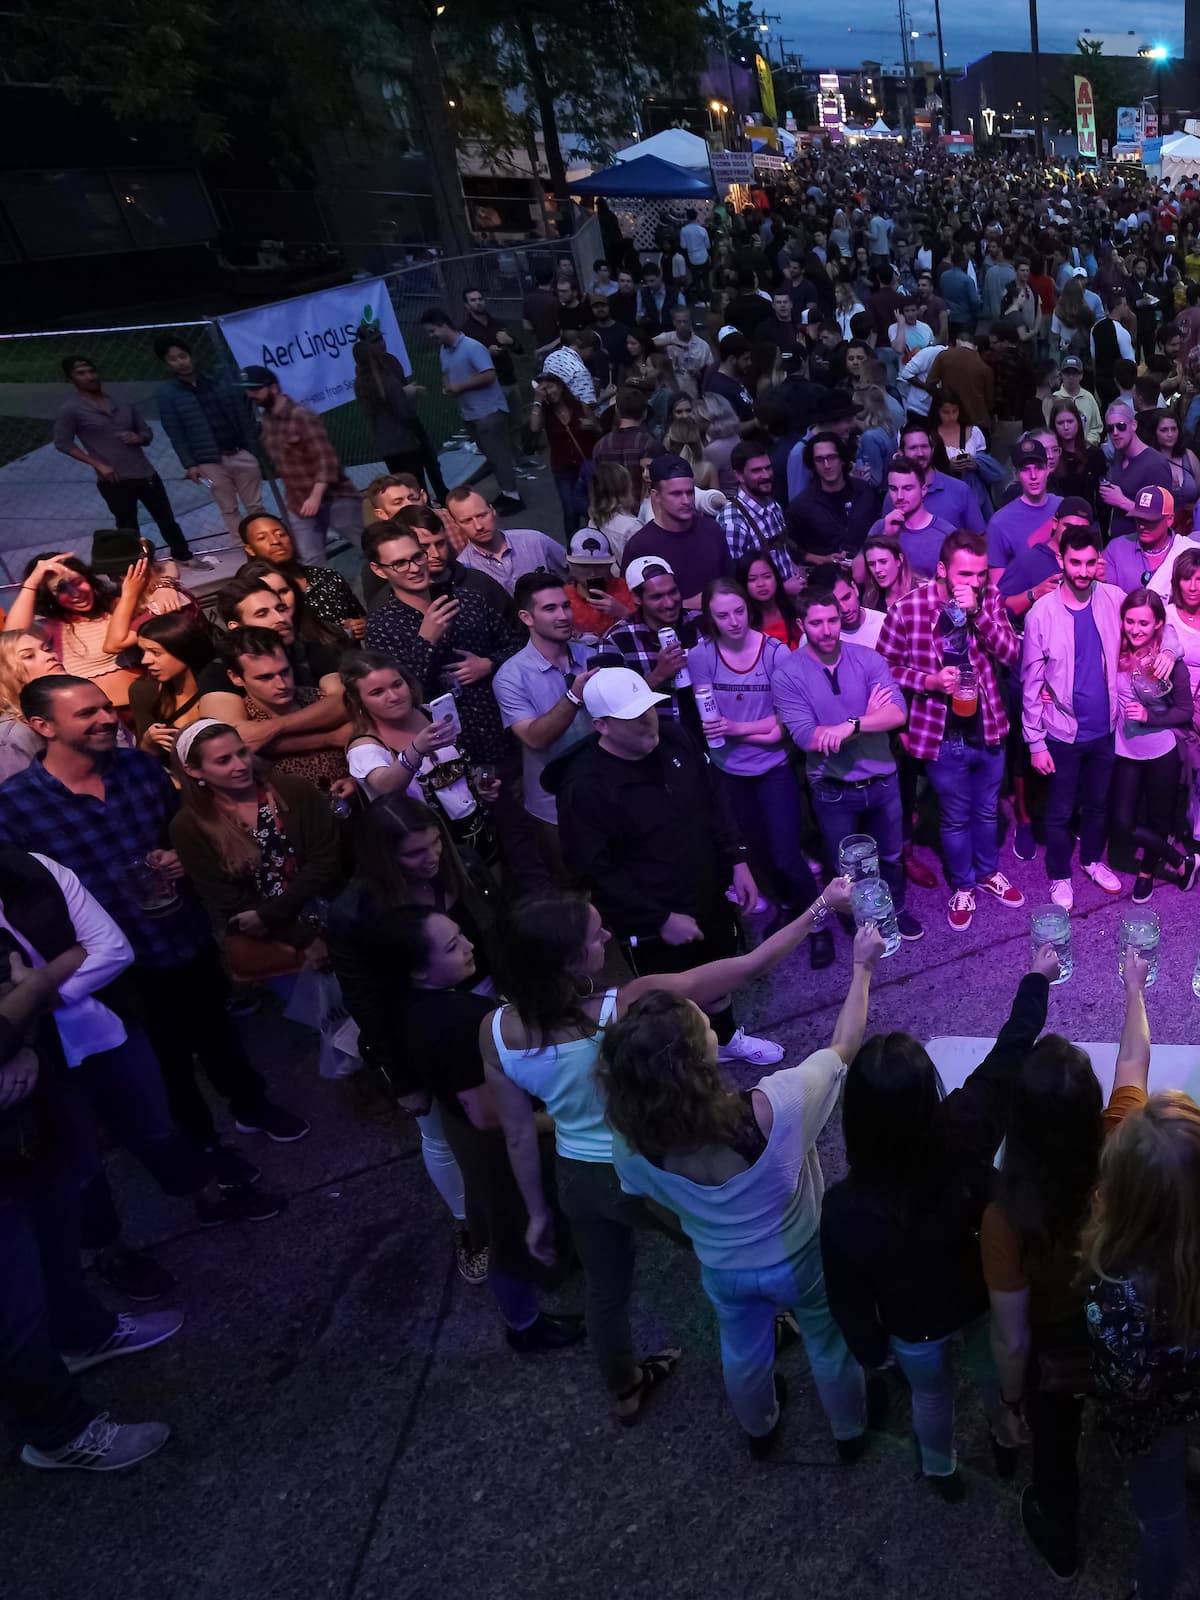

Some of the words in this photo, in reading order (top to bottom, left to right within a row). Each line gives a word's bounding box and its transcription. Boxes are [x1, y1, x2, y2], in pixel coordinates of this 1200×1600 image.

[1077, 82, 1095, 152] ATM
[262, 342, 296, 369] Aer
[296, 323, 359, 359] Lingus
